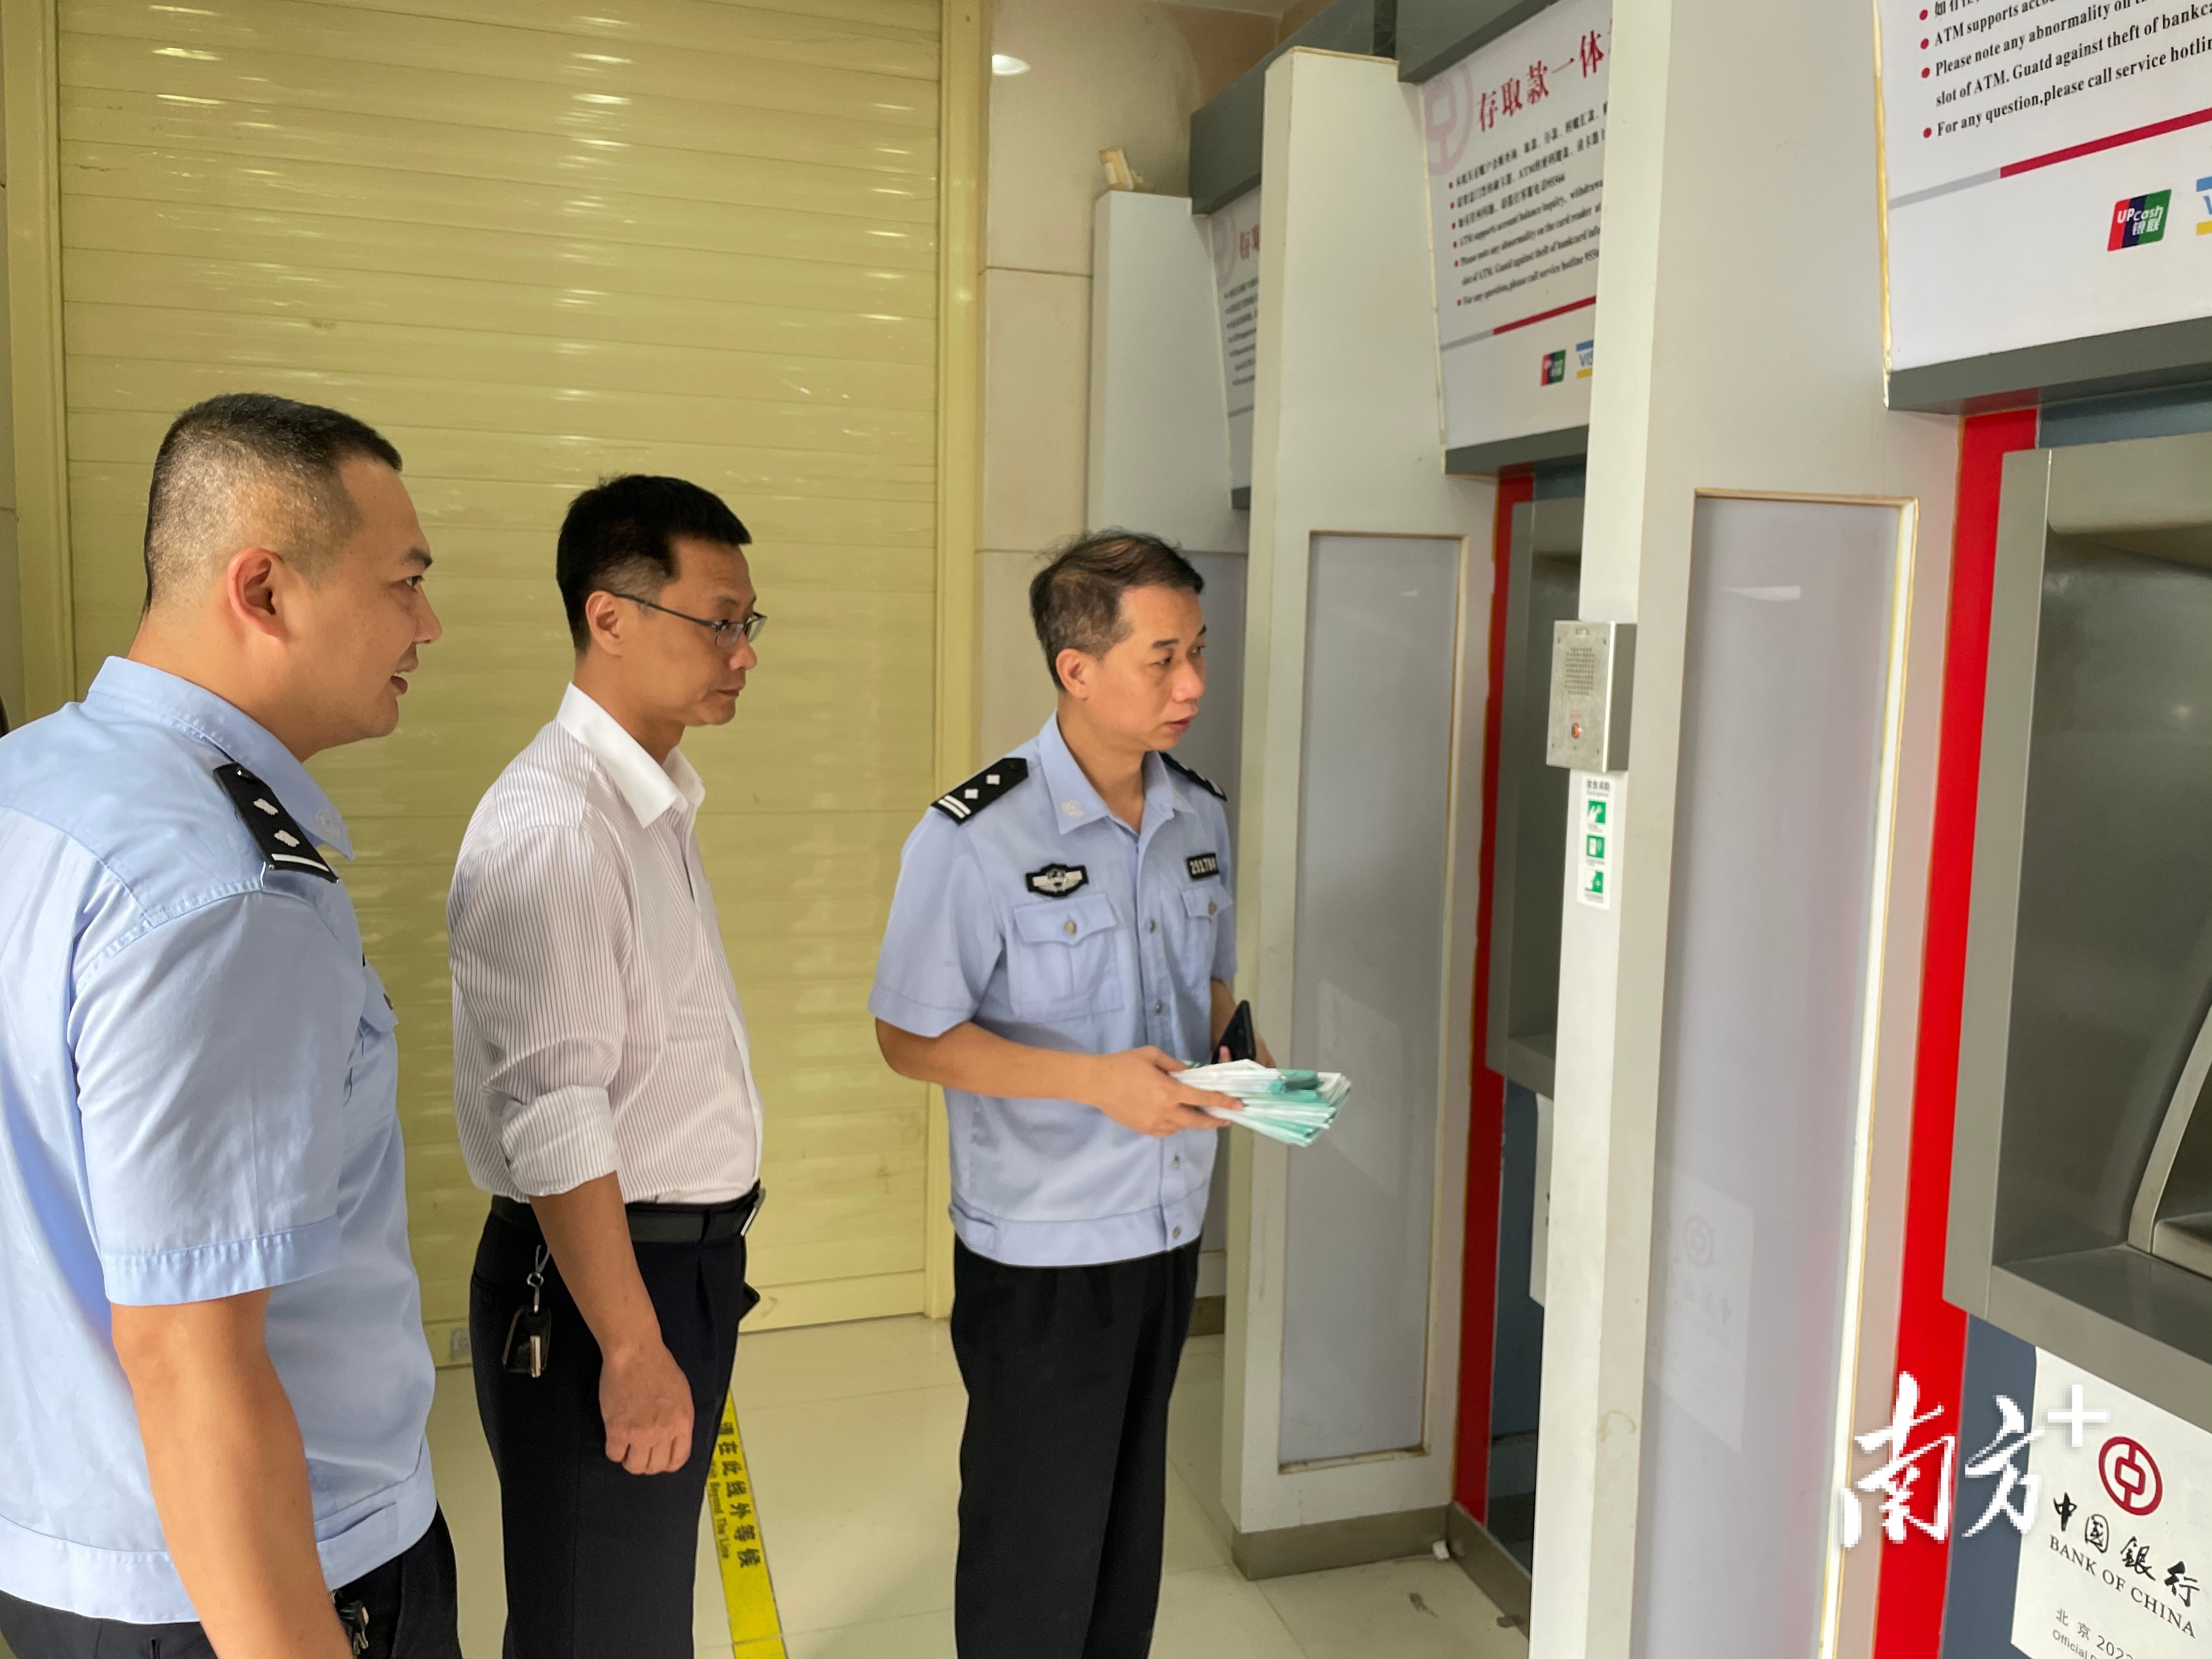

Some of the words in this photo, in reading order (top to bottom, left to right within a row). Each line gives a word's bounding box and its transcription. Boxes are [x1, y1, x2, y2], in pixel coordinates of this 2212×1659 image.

[1934, 22, 1963, 47] ATM
[1967, 5, 2018, 34] supports
[1936, 55, 1972, 76] Please
[1975, 43, 2000, 63] note
[2004, 34, 2025, 50] any
[2029, 3, 2111, 42] abnormality
[1936, 89, 1956, 106] slot
[1960, 82, 1972, 98] of
[1974, 70, 2009, 94] ATM.
[2056, 38, 2103, 66] against
[2107, 24, 2140, 48] theft
[2144, 16, 2159, 35] of
[1478, 29, 1613, 132] 存取款一体
[1938, 121, 1958, 137] For
[1961, 113, 1982, 127] any
[2087, 67, 2112, 88] call
[2115, 54, 2166, 80] service
[2050, 1534, 2096, 1576] BANK
[2102, 1570, 2126, 1592] OF
[2131, 1587, 2196, 1639] CHINA
[2056, 1608, 2091, 1640] 北京
